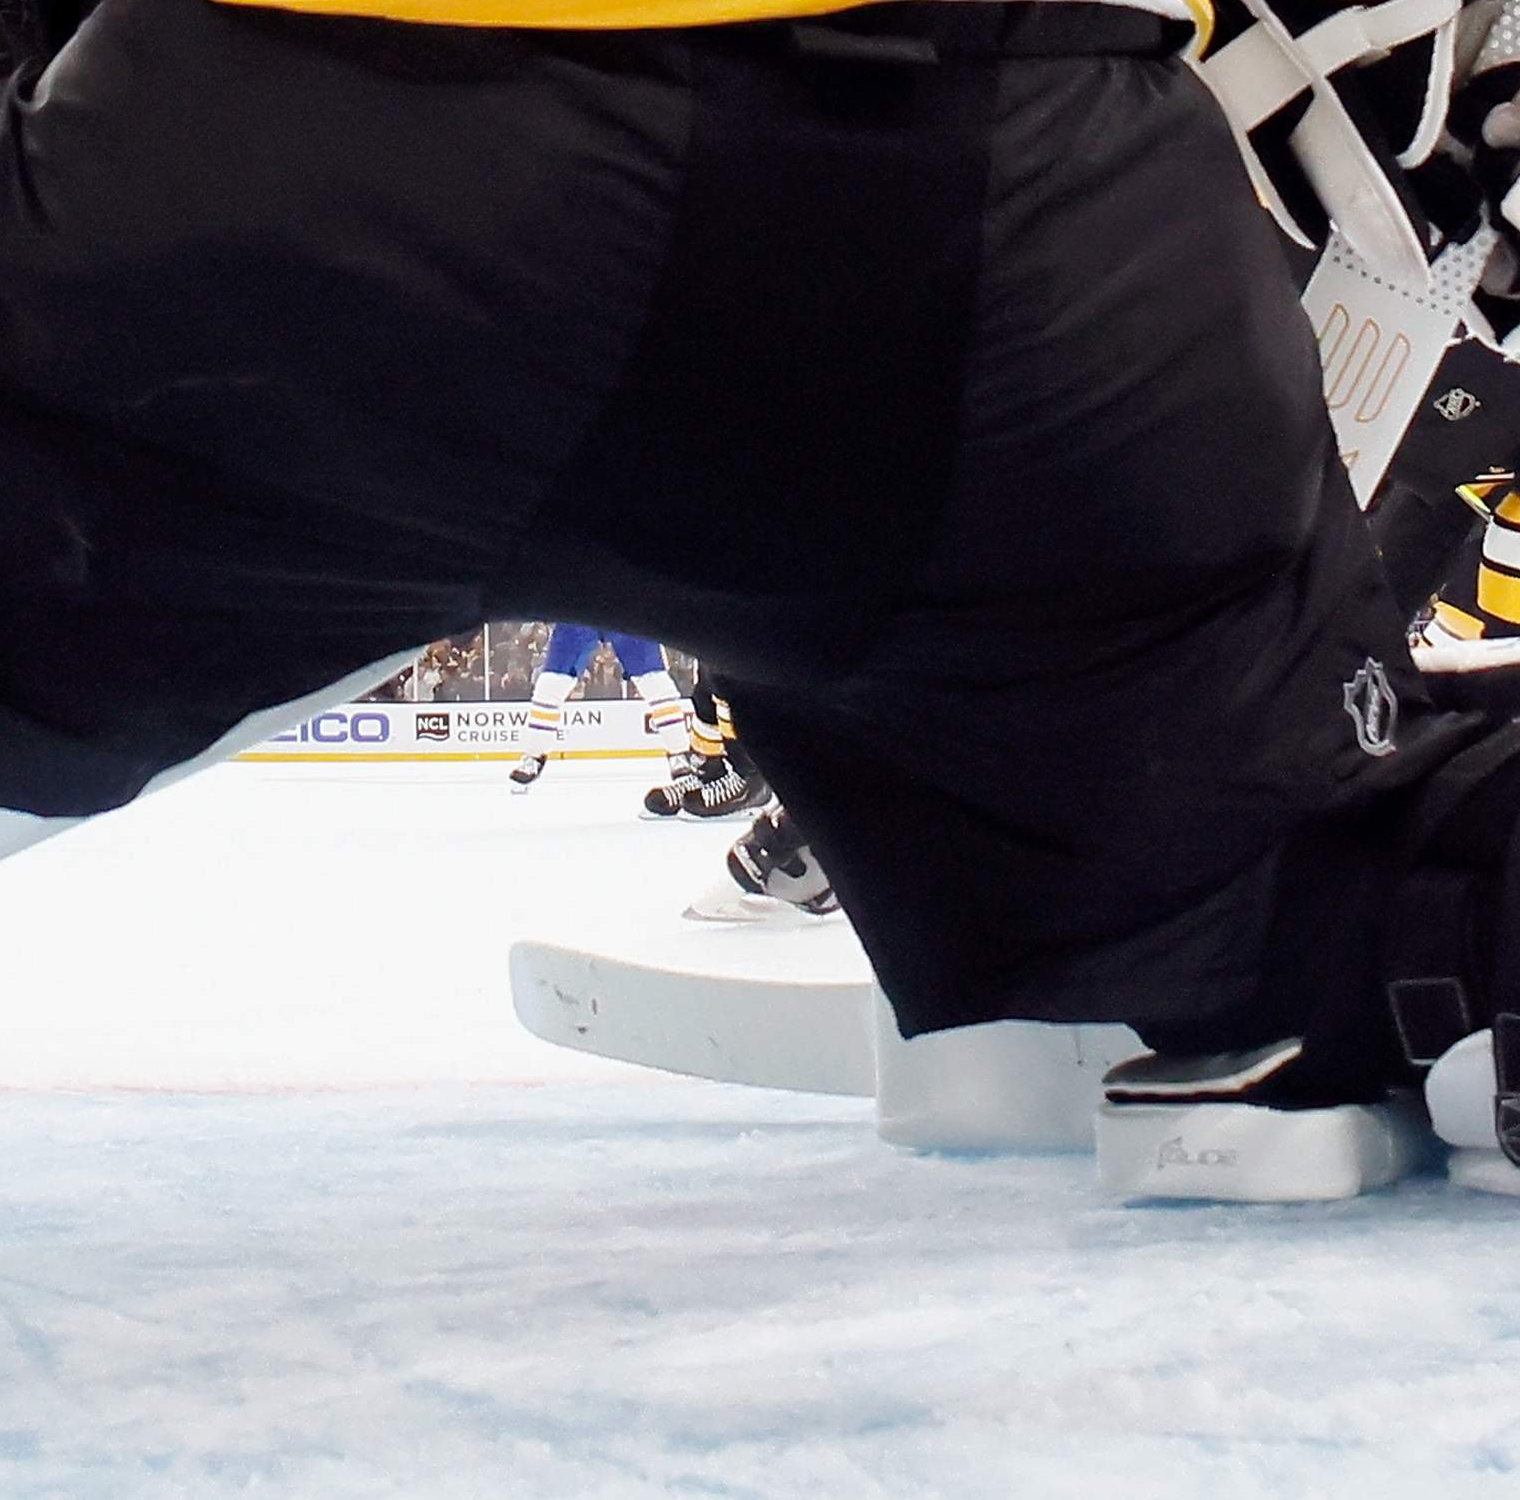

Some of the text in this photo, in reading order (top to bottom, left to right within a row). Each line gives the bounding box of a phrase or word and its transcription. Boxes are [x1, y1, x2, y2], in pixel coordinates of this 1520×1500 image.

[417, 715, 450, 732] NCL
[456, 710, 603, 727] NORWIAN
[457, 729, 521, 743] CRUISE
